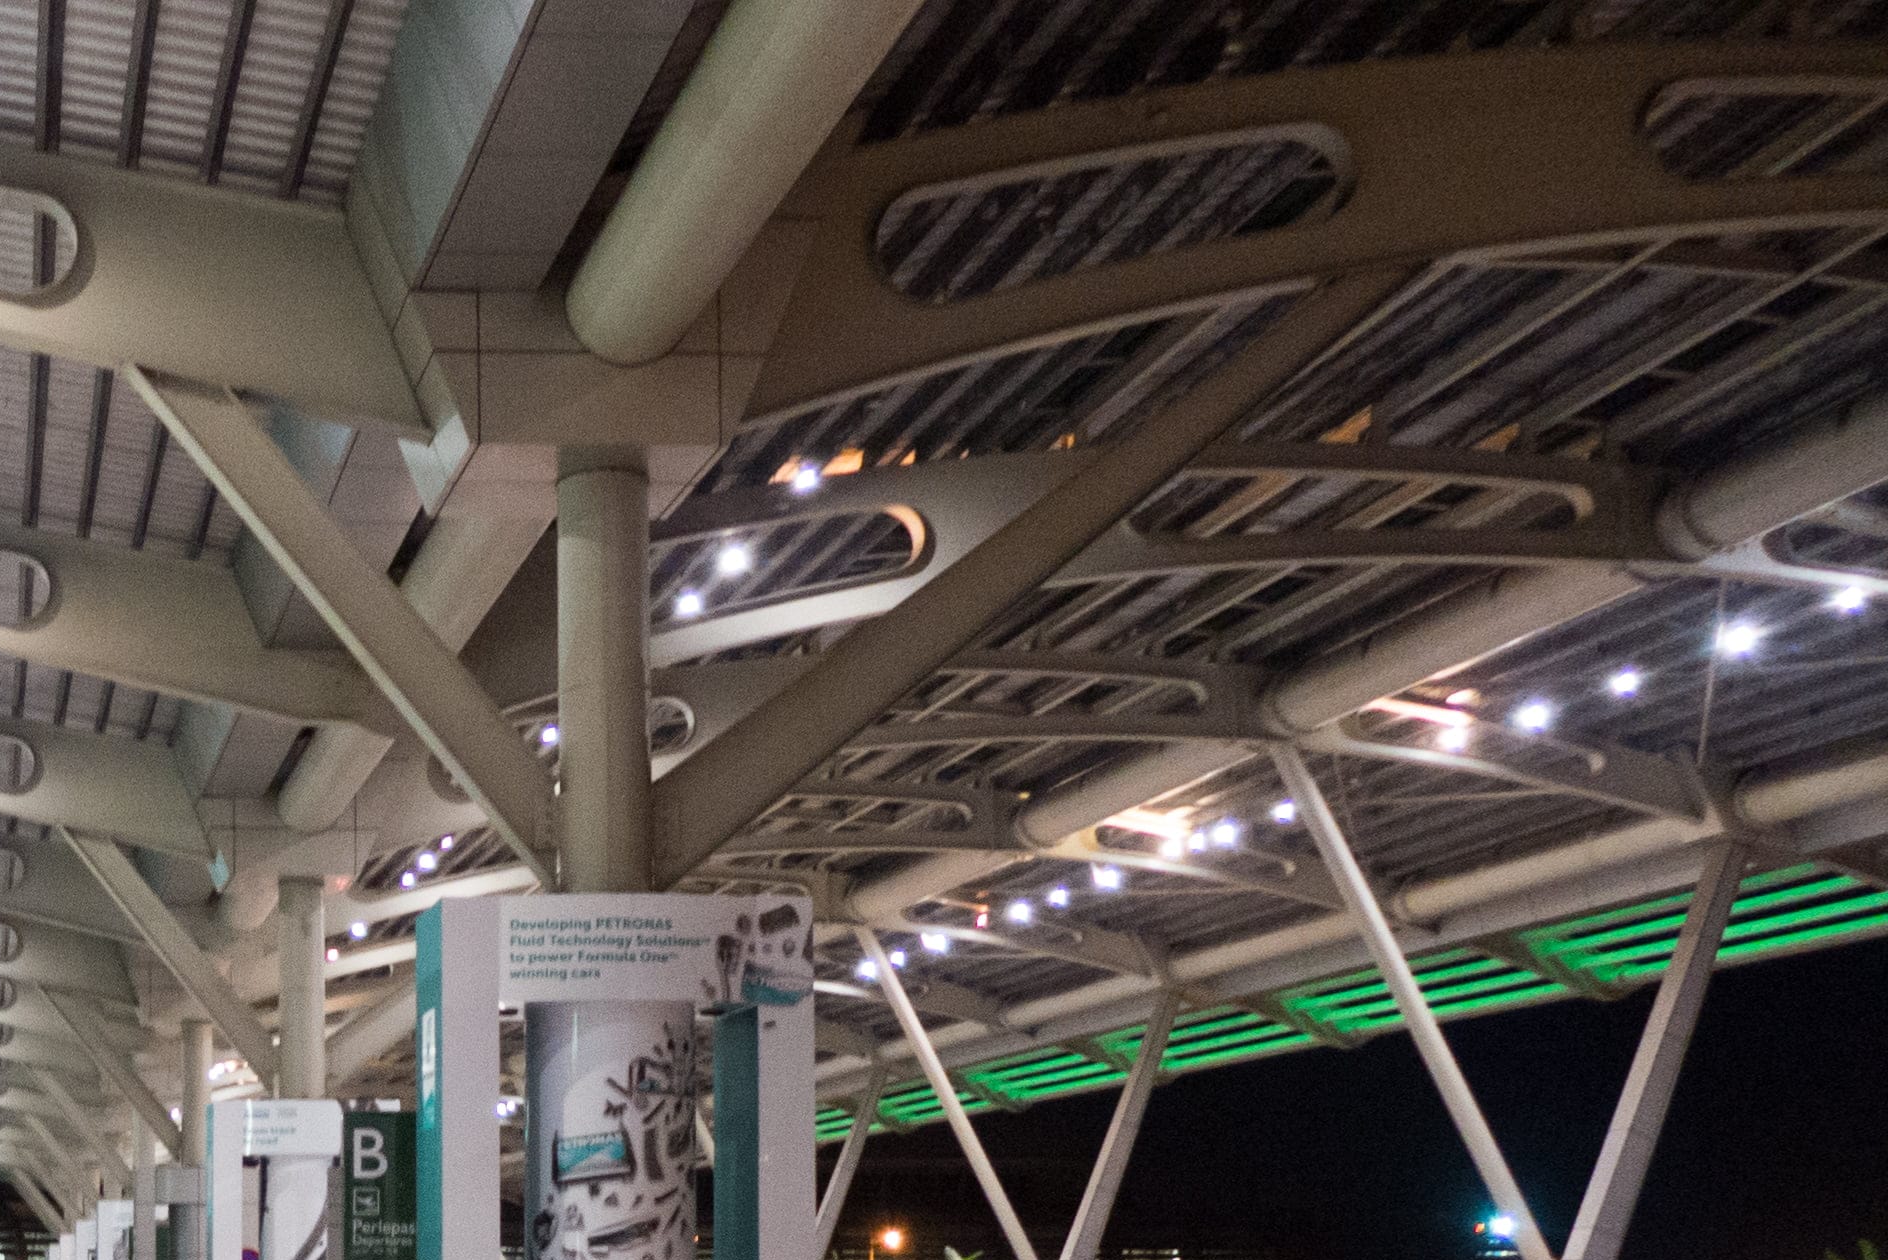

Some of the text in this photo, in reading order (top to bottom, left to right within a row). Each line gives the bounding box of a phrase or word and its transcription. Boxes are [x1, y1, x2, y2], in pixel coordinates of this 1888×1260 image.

[510, 917, 673, 932] Developing PETRONAS
[510, 934, 545, 946] Fluid
[550, 934, 633, 950] Technology
[510, 952, 525, 963] to
[528, 953, 573, 966] power
[577, 950, 637, 963] Formula
[510, 968, 601, 982] winning cars
[352, 1127, 388, 1179] B
